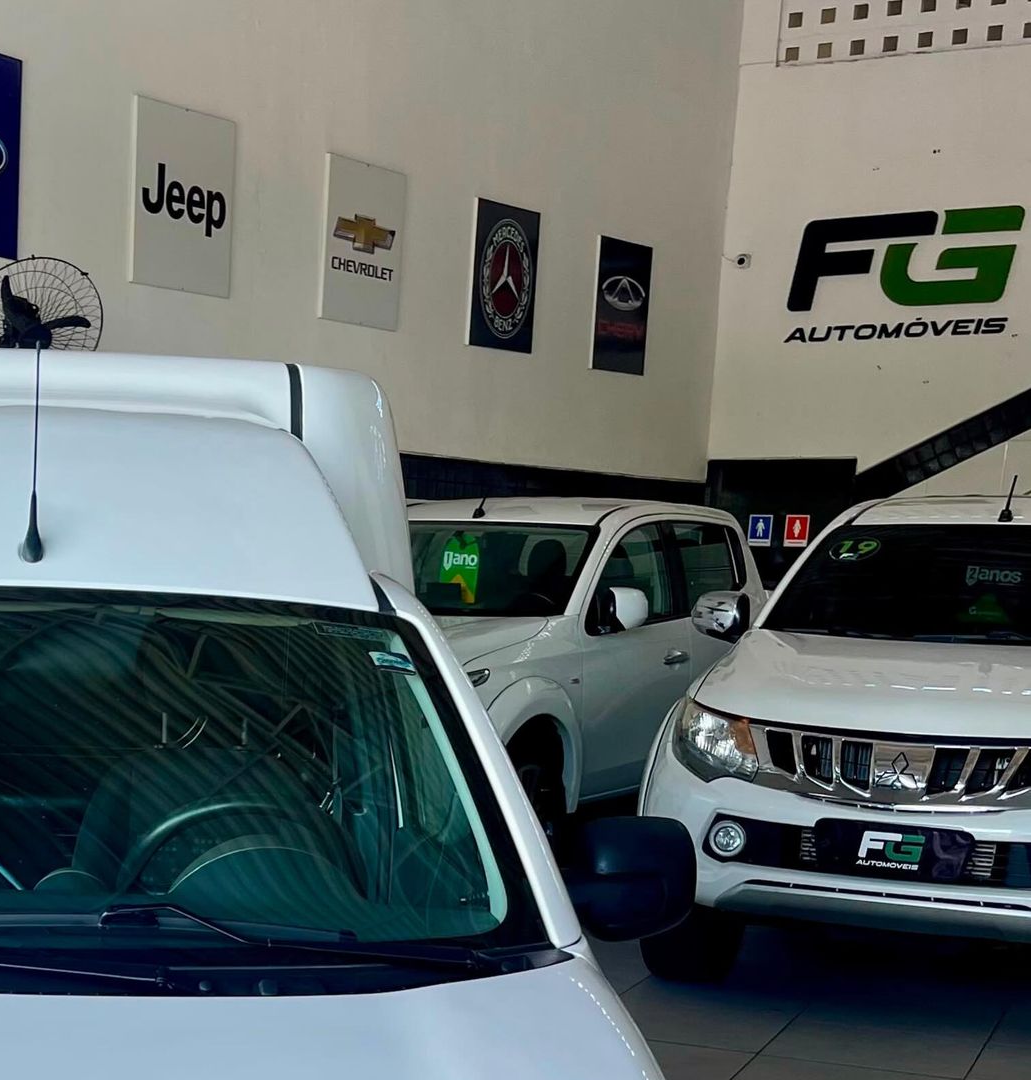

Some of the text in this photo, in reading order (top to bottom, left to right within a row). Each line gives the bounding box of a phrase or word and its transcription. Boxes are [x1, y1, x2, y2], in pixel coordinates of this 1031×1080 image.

[142, 163, 227, 237] Jeep
[492, 226, 526, 253] MERCEDES
[331, 256, 394, 281] CHEVROLET
[786, 205, 1026, 312] FG
[493, 316, 514, 332] BENZ
[782, 317, 1009, 344] AUTOMÓVEIS
[839, 540, 878, 554] 19
[857, 830, 926, 863] FG
